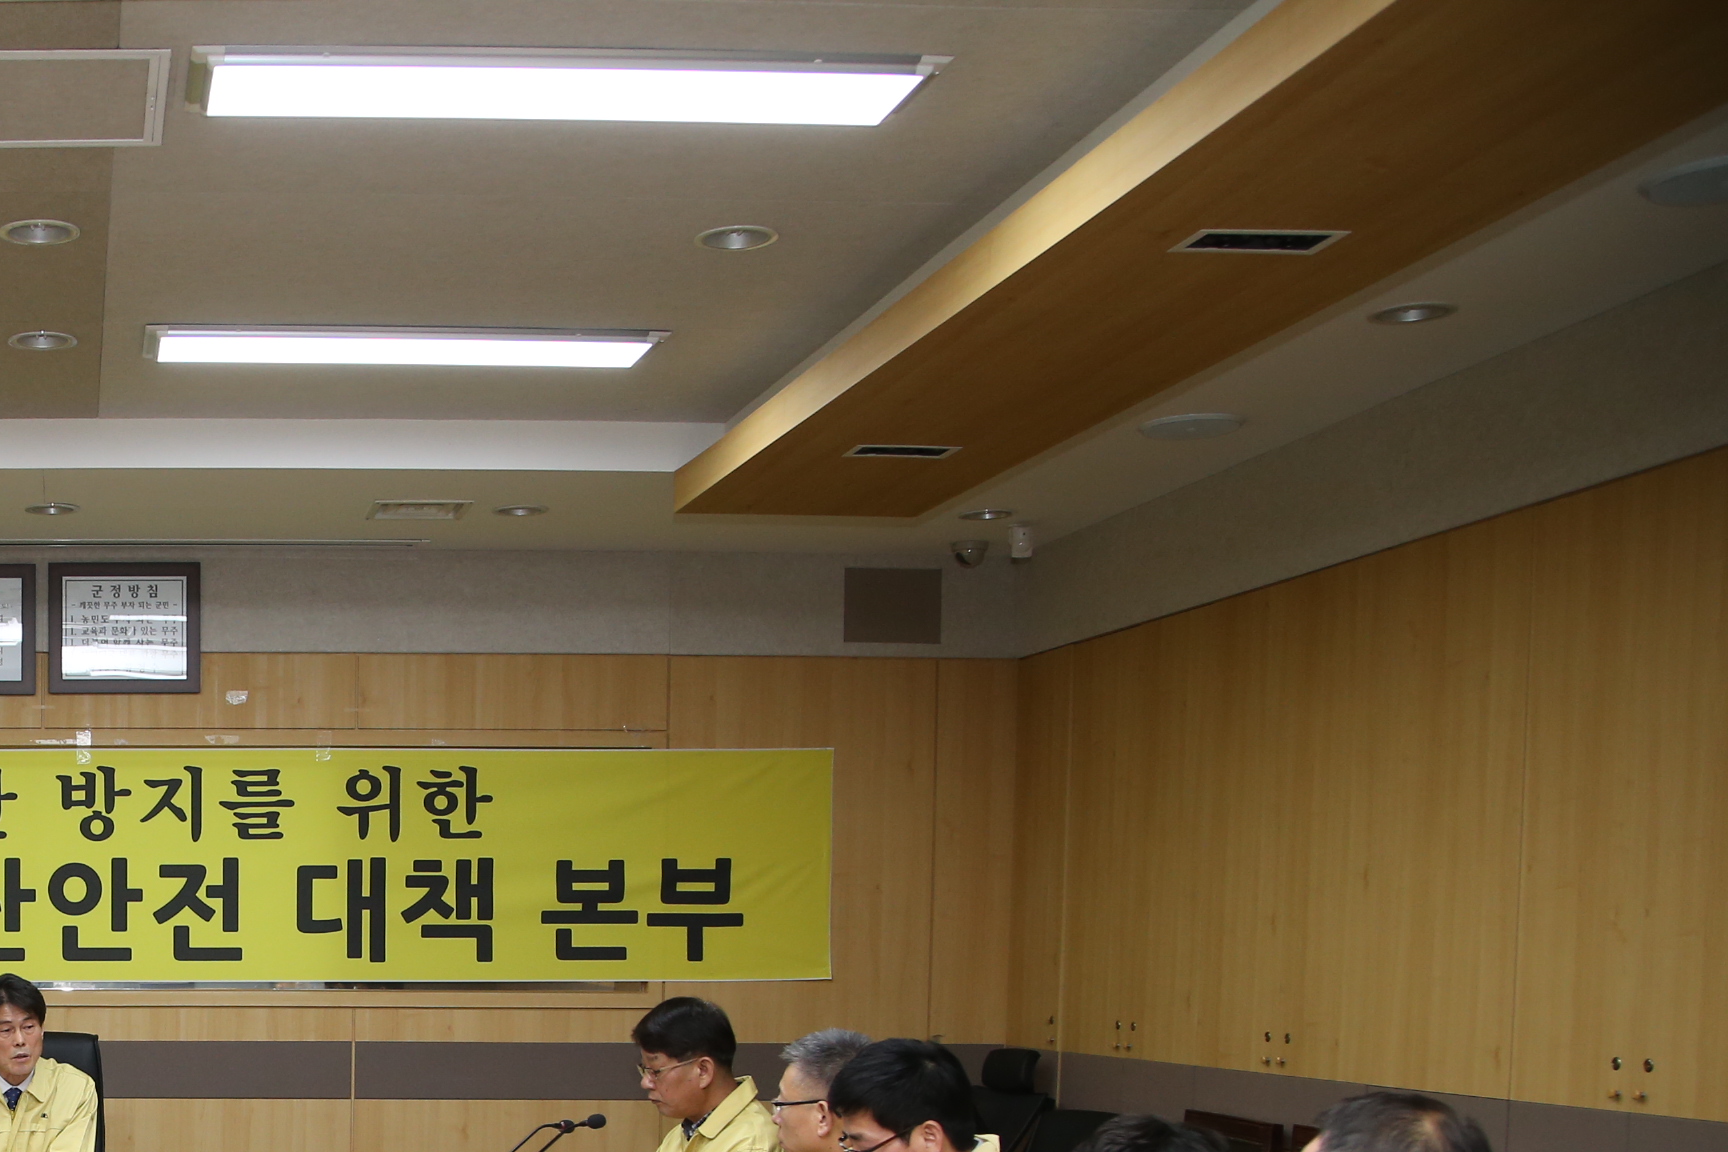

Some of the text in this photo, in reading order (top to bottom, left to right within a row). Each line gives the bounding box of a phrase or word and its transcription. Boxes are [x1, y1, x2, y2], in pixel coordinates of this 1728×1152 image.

[91, 584, 159, 598] 군정방침
[104, 602, 117, 610] 무주
[81, 626, 106, 636] 교육과
[140, 626, 157, 636] 있는
[162, 626, 178, 636] 무주
[55, 765, 295, 843] 방지를
[336, 765, 494, 843] 위한
[296, 856, 494, 963] 대책
[540, 857, 745, 962] 본부
